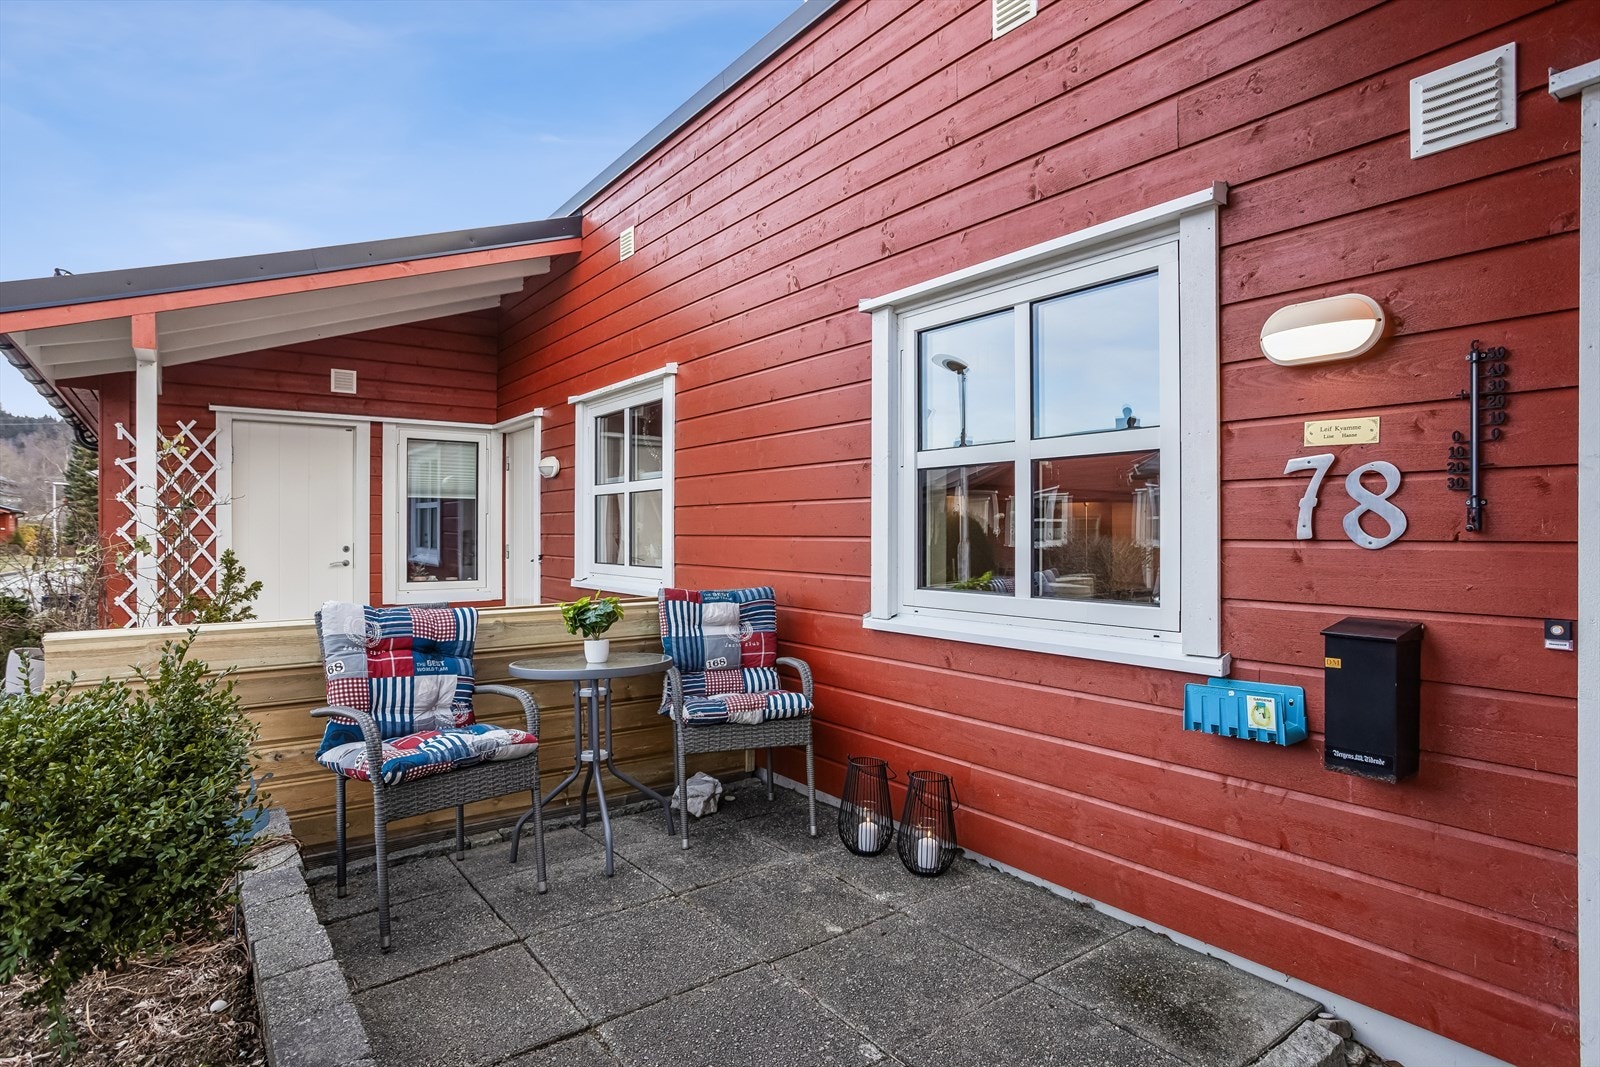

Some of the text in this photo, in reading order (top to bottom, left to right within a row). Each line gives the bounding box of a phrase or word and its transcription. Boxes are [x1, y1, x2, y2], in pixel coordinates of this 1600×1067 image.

[1488, 379, 1506, 392] 30
[1487, 395, 1506, 408] 20
[1489, 411, 1506, 424] 10
[1451, 430, 1462, 442] 0
[1448, 446, 1465, 458] 10
[1447, 462, 1465, 474] 20
[1447, 477, 1465, 489] 30
[1283, 453, 1408, 550] 78
[707, 657, 726, 669] 168
